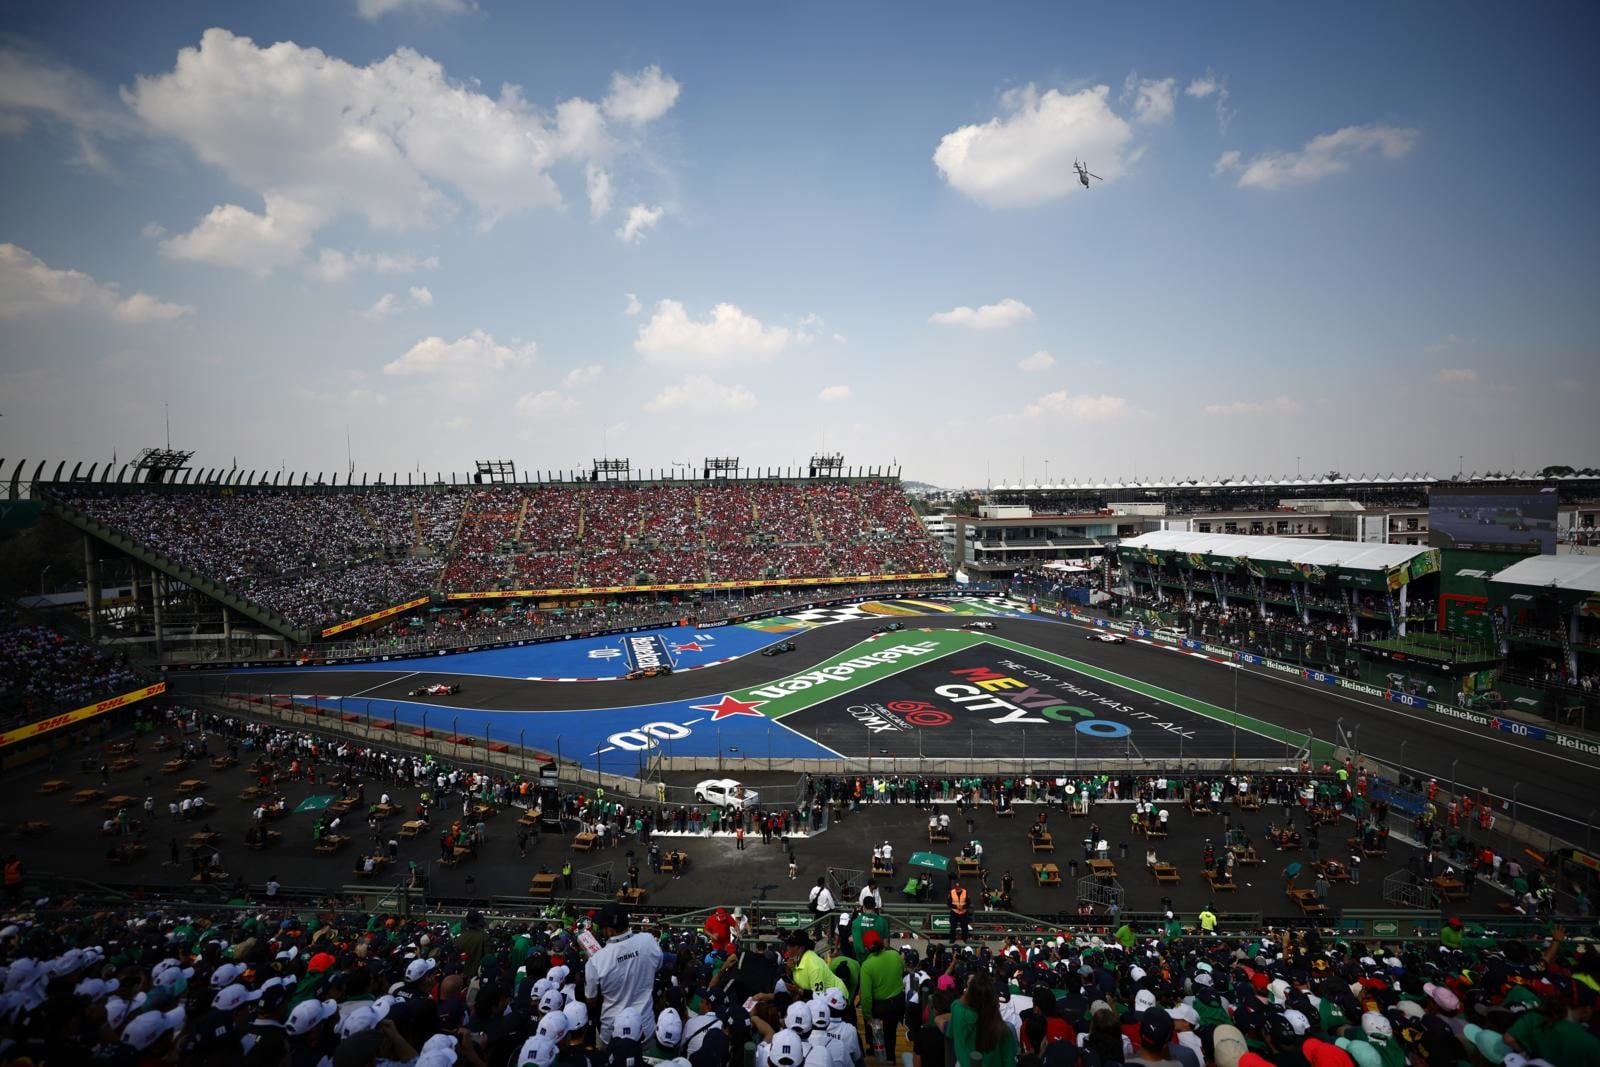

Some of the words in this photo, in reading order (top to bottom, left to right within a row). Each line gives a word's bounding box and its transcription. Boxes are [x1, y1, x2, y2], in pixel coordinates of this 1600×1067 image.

[1206, 644, 1232, 658] Heineken
[749, 641, 941, 698] Heineken
[1266, 661, 1300, 675] Heineken
[1342, 680, 1382, 696] Heineken
[96, 697, 125, 712] DHL
[934, 684, 1049, 724] CITY
[951, 667, 1131, 738] MEXICO
[1401, 695, 1414, 706] 0.0
[1056, 682, 1099, 696] THAT
[1092, 697, 1134, 712] HAS
[1152, 723, 1196, 739] ALL
[1435, 704, 1487, 725] Heineken
[37, 715, 71, 732] DHL
[1512, 724, 1528, 736] 0.0
